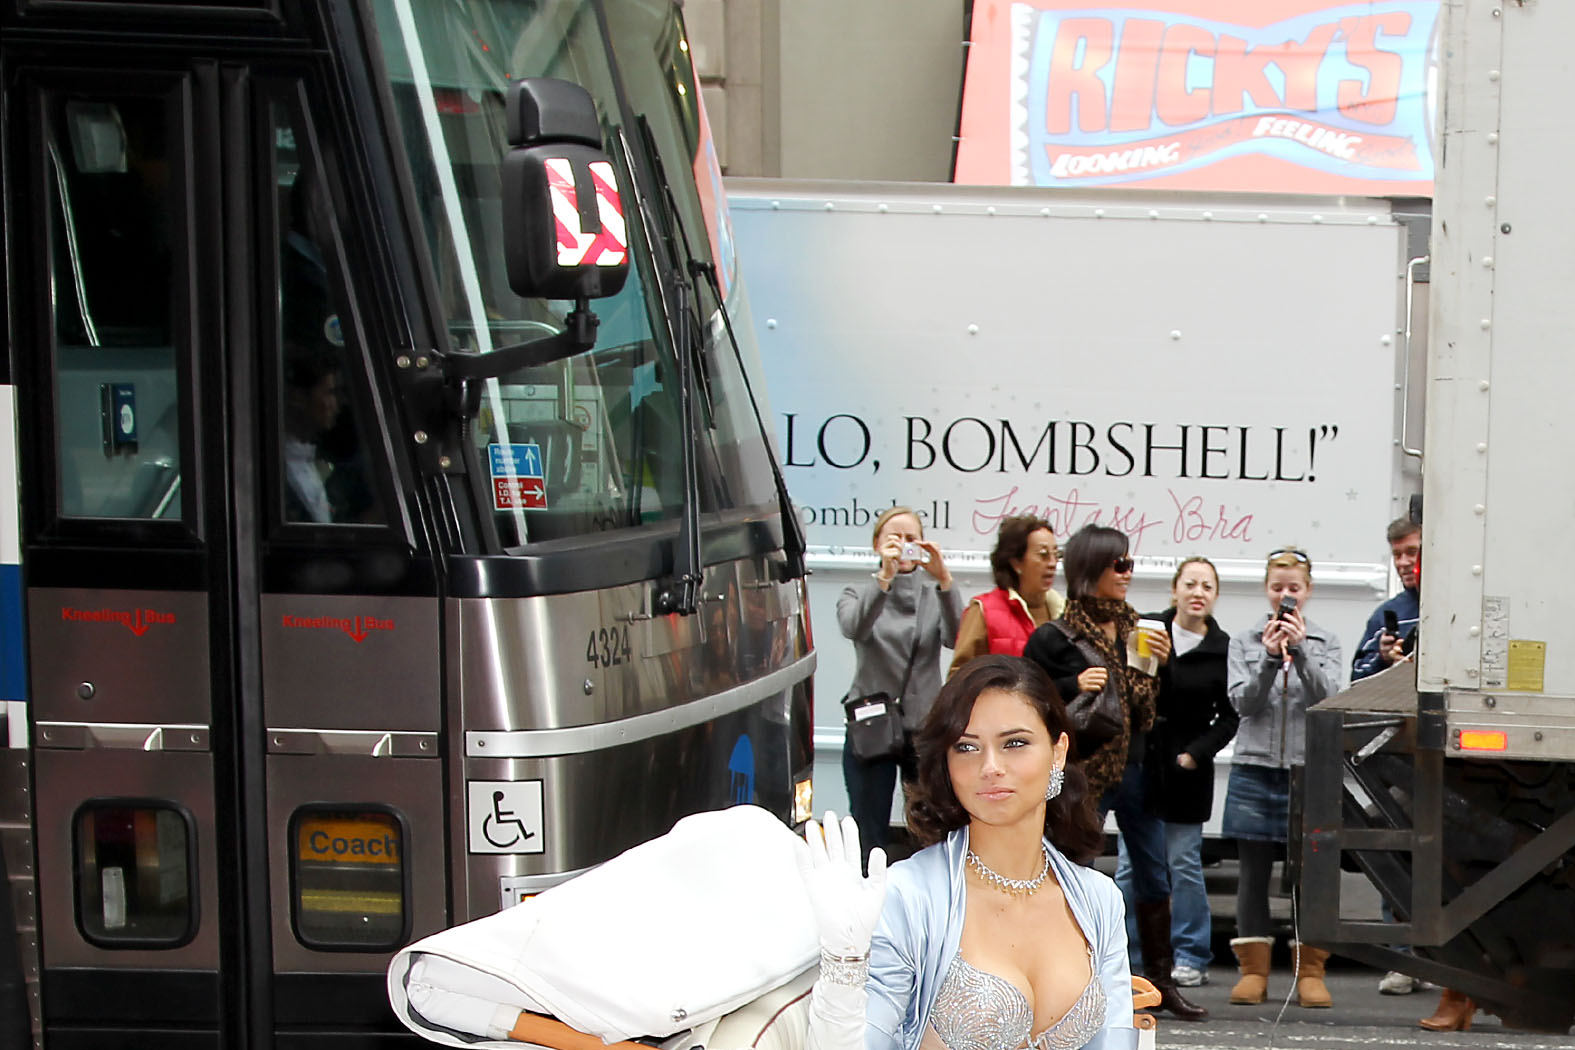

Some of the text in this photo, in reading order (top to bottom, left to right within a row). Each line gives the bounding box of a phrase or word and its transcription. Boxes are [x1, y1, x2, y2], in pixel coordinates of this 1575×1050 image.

[1045, 11, 1413, 135] RICKY'S
[1252, 116, 1363, 160] FEELING
[1050, 142, 1181, 177] LOOKING
[801, 498, 951, 529] ombell
[1168, 488, 1254, 544] Bra
[61, 607, 176, 627] Kneeling Bus
[282, 614, 395, 633] Kneeling Bus
[586, 624, 632, 669] 4324
[309, 829, 399, 857] Coach
